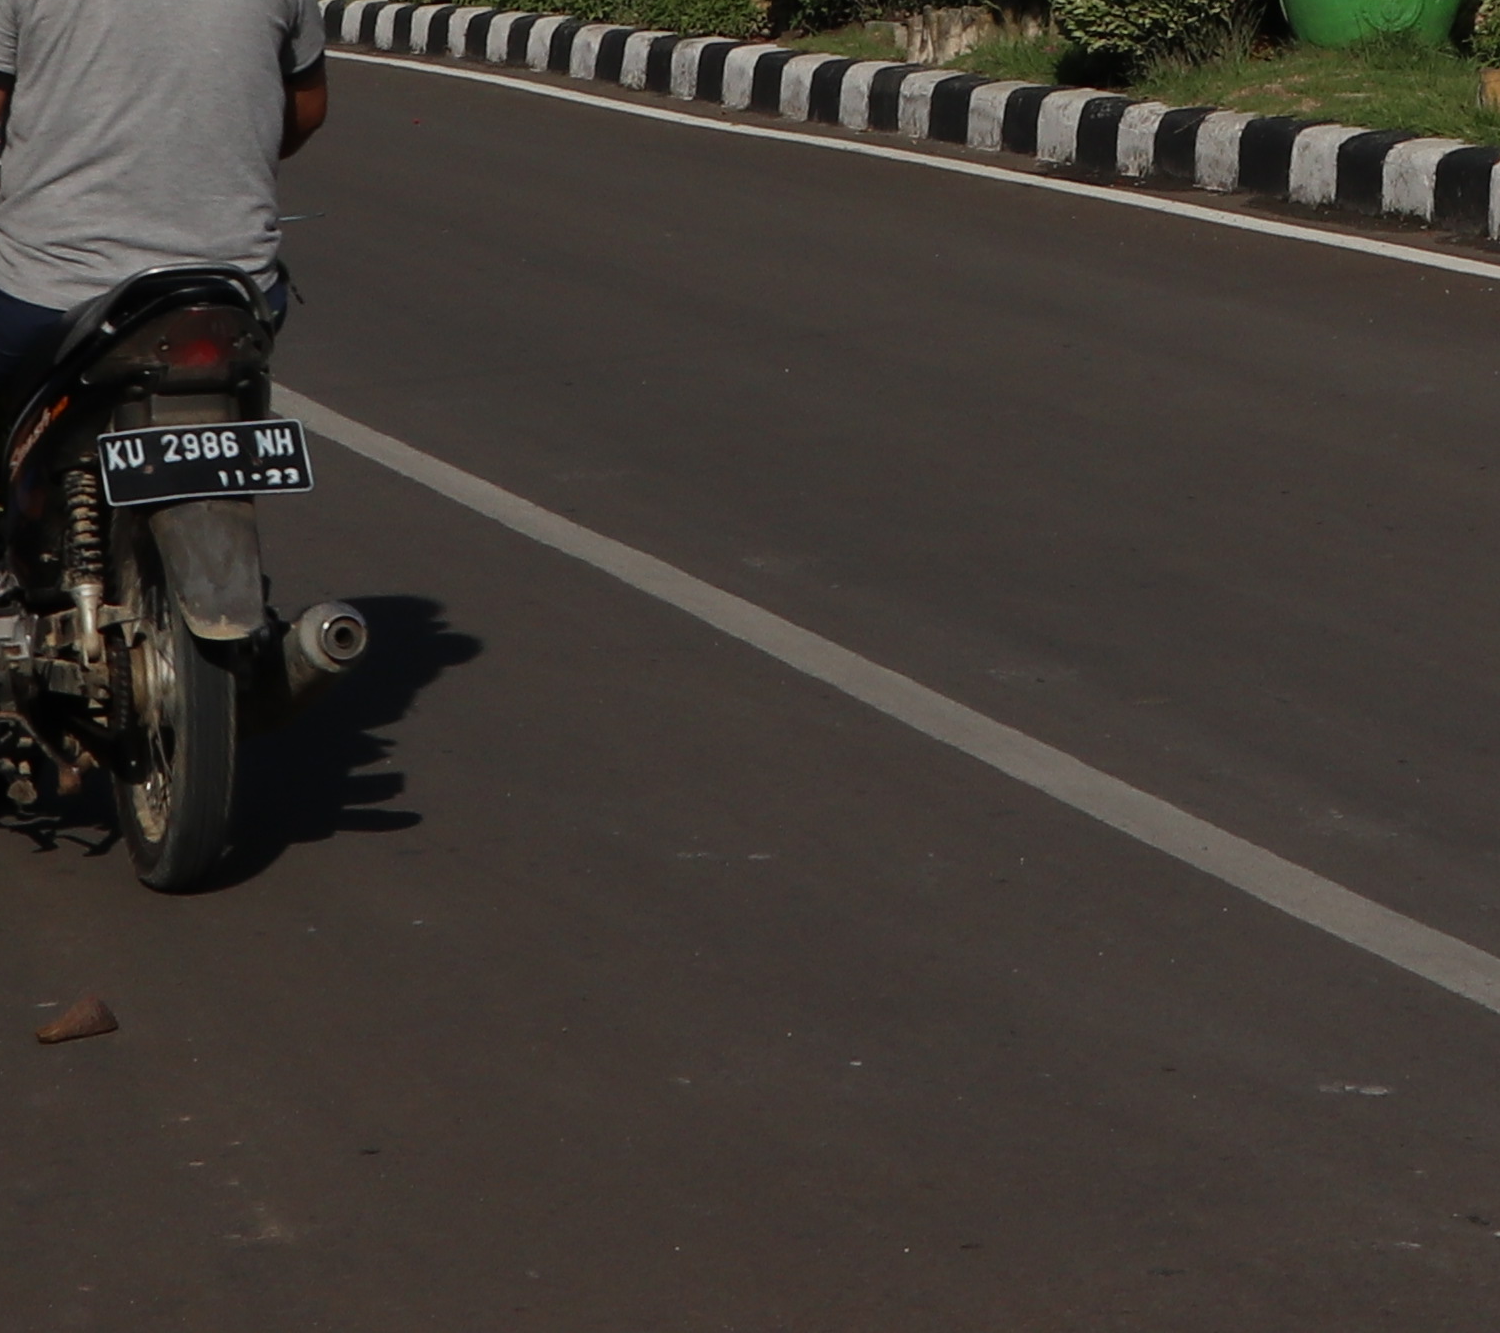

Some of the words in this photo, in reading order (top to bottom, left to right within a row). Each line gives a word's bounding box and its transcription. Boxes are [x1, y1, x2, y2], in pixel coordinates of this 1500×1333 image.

[104, 439, 146, 471] KU
[160, 430, 240, 464] 2986
[253, 427, 295, 459] NH
